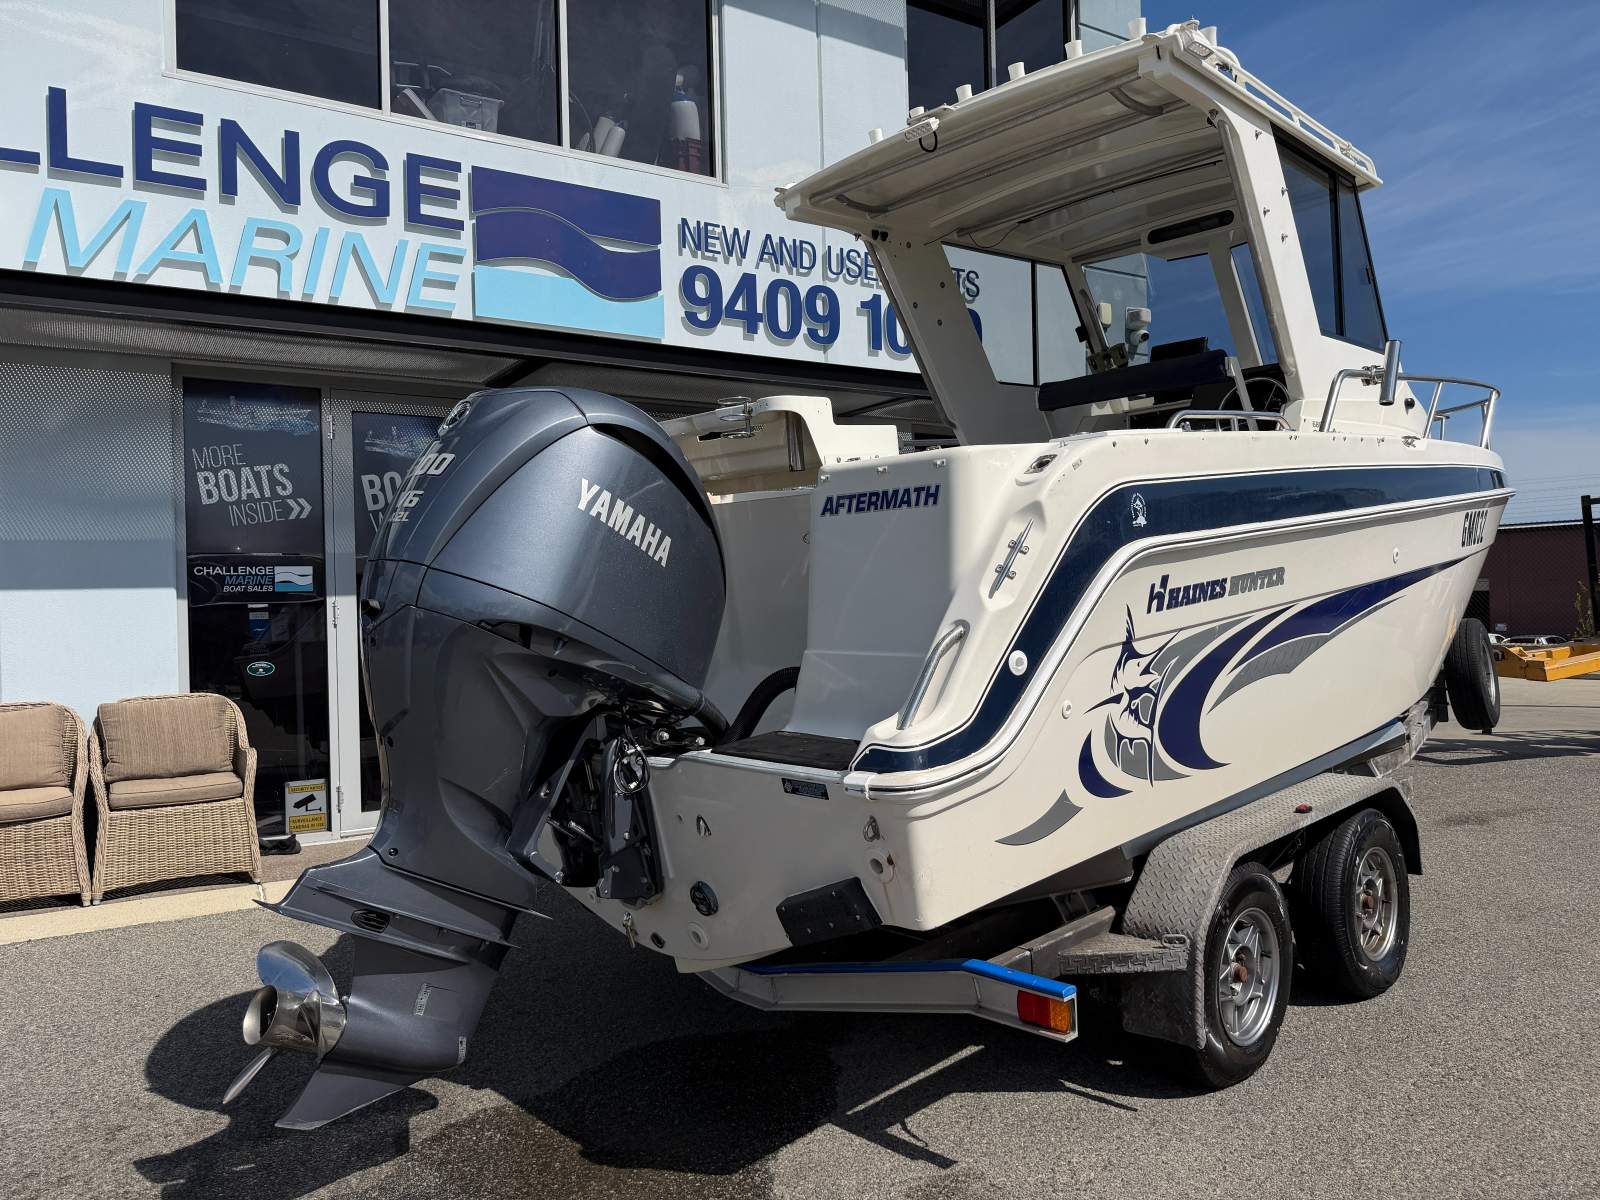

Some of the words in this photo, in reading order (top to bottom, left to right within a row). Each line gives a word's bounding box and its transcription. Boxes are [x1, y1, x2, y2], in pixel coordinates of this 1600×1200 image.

[23, 187, 467, 311] MARINE
[680, 217, 751, 259] NEW
[759, 233, 817, 271] AND
[827, 245, 879, 282] USE
[681, 264, 841, 345] 9409
[191, 443, 246, 470] MORE
[197, 463, 293, 505] BOATS
[820, 484, 941, 516] AFTERMATH
[228, 499, 286, 527] INSIDE
[578, 478, 672, 568] YAMAHA
[193, 565, 274, 575] CHALLENGE
[224, 575, 273, 585] MARINE
[1166, 577, 1228, 611] HAINES
[1228, 566, 1286, 597] HUNTER
[223, 585, 245, 593] BOAT
